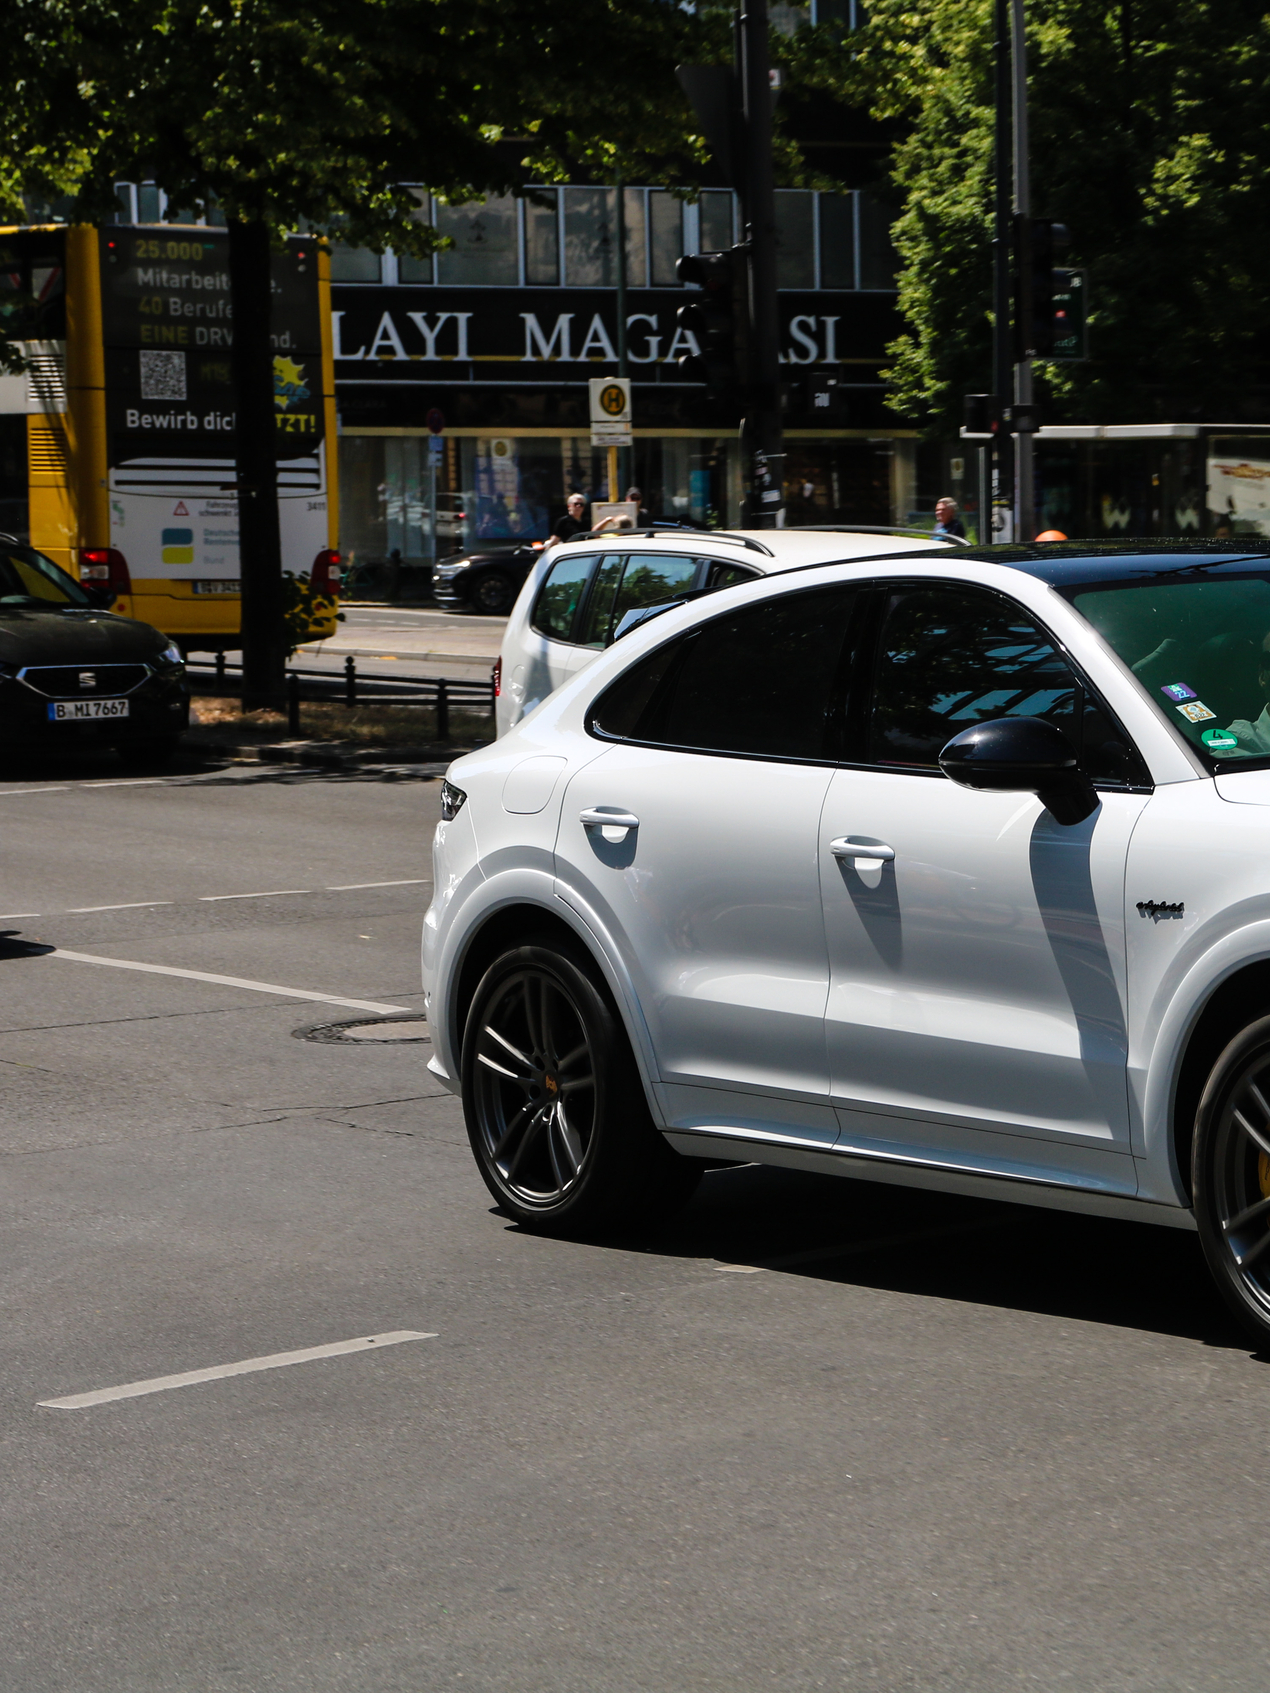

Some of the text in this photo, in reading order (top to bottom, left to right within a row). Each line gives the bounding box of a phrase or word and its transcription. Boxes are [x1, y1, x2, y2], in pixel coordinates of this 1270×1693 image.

[135, 239, 203, 260] 25.000
[138, 296, 163, 315] 40
[140, 324, 190, 344] EINE
[519, 312, 842, 364] MAGASI
[608, 392, 620, 409] H
[126, 408, 198, 430] Bewirb
[1174, 690, 1191, 699] 22
[57, 701, 126, 718] B MI 7667
[1213, 730, 1223, 740] 4
